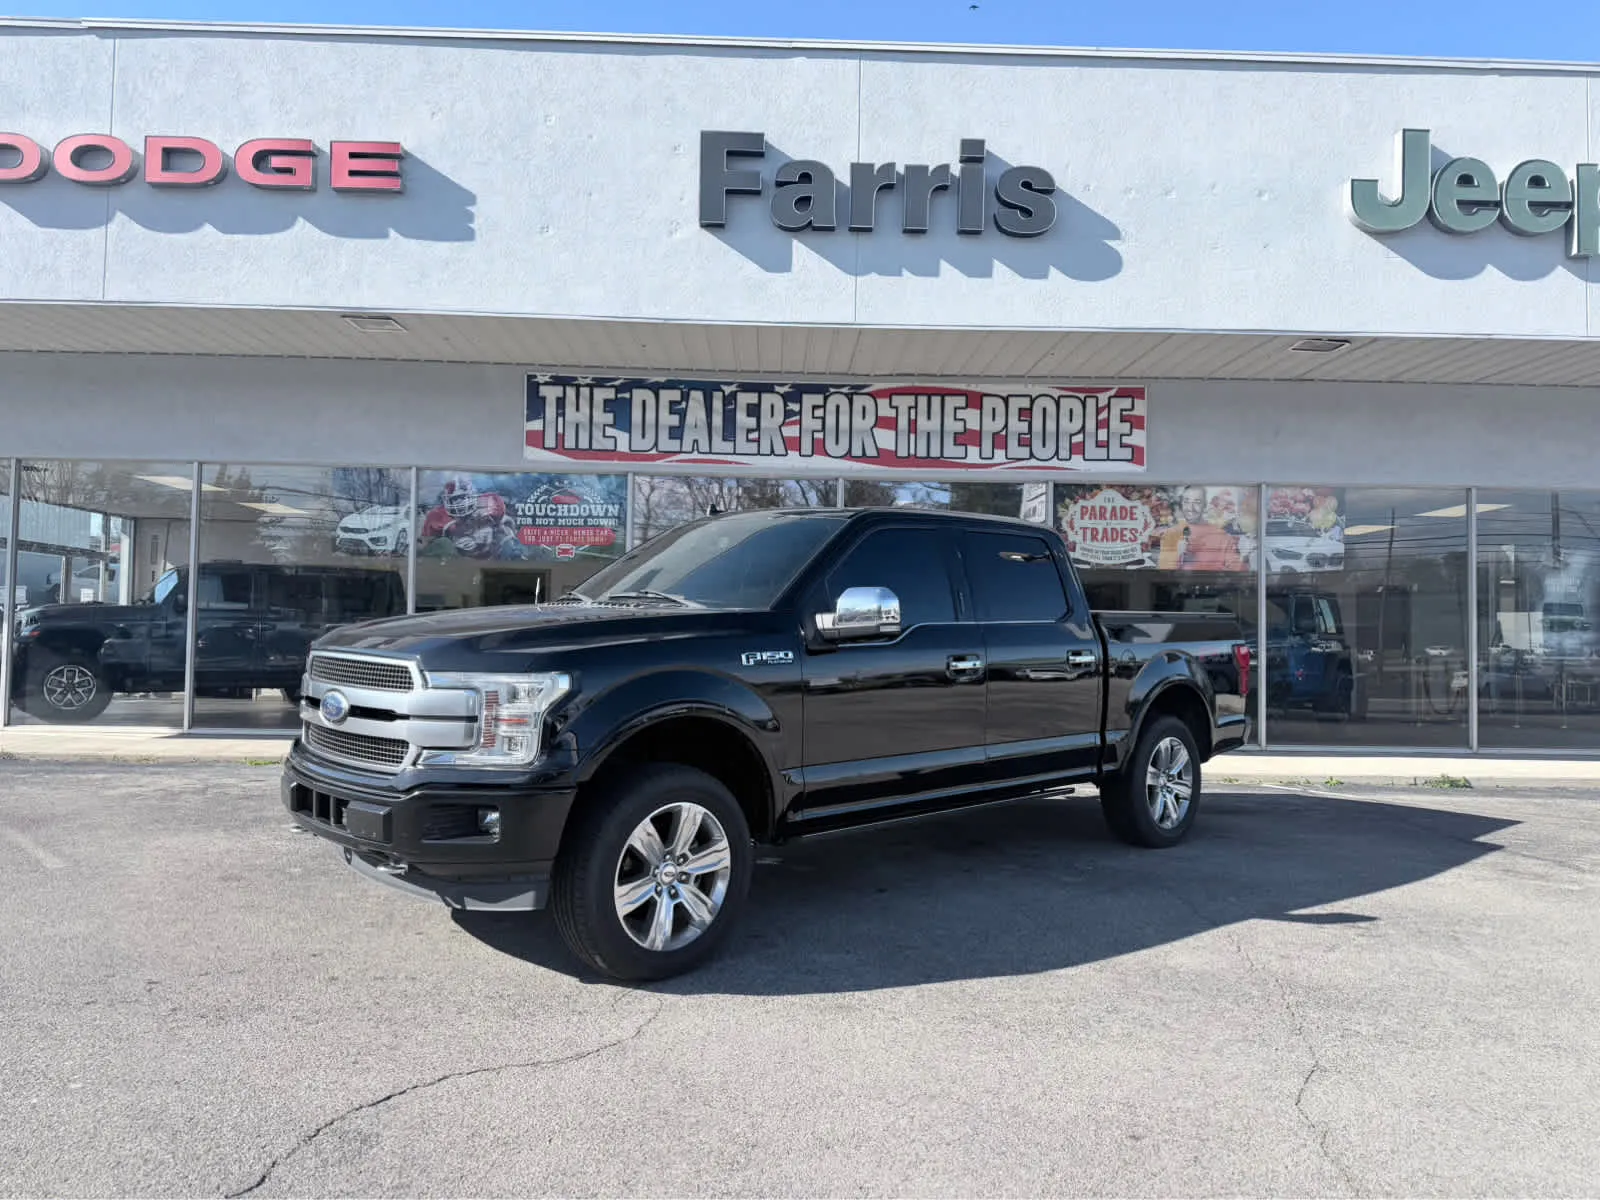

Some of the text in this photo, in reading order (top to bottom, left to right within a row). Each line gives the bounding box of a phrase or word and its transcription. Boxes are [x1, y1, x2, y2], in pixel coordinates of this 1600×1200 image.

[700, 130, 1057, 237] Farris
[538, 385, 1134, 461] THE DEALER FOR THE PEOPLE
[515, 503, 619, 516] TOUCHDOWN
[1079, 505, 1138, 521] PARADE
[517, 517, 533, 525] FOR
[558, 518, 585, 526] MUCH
[1079, 527, 1139, 543] TRADES
